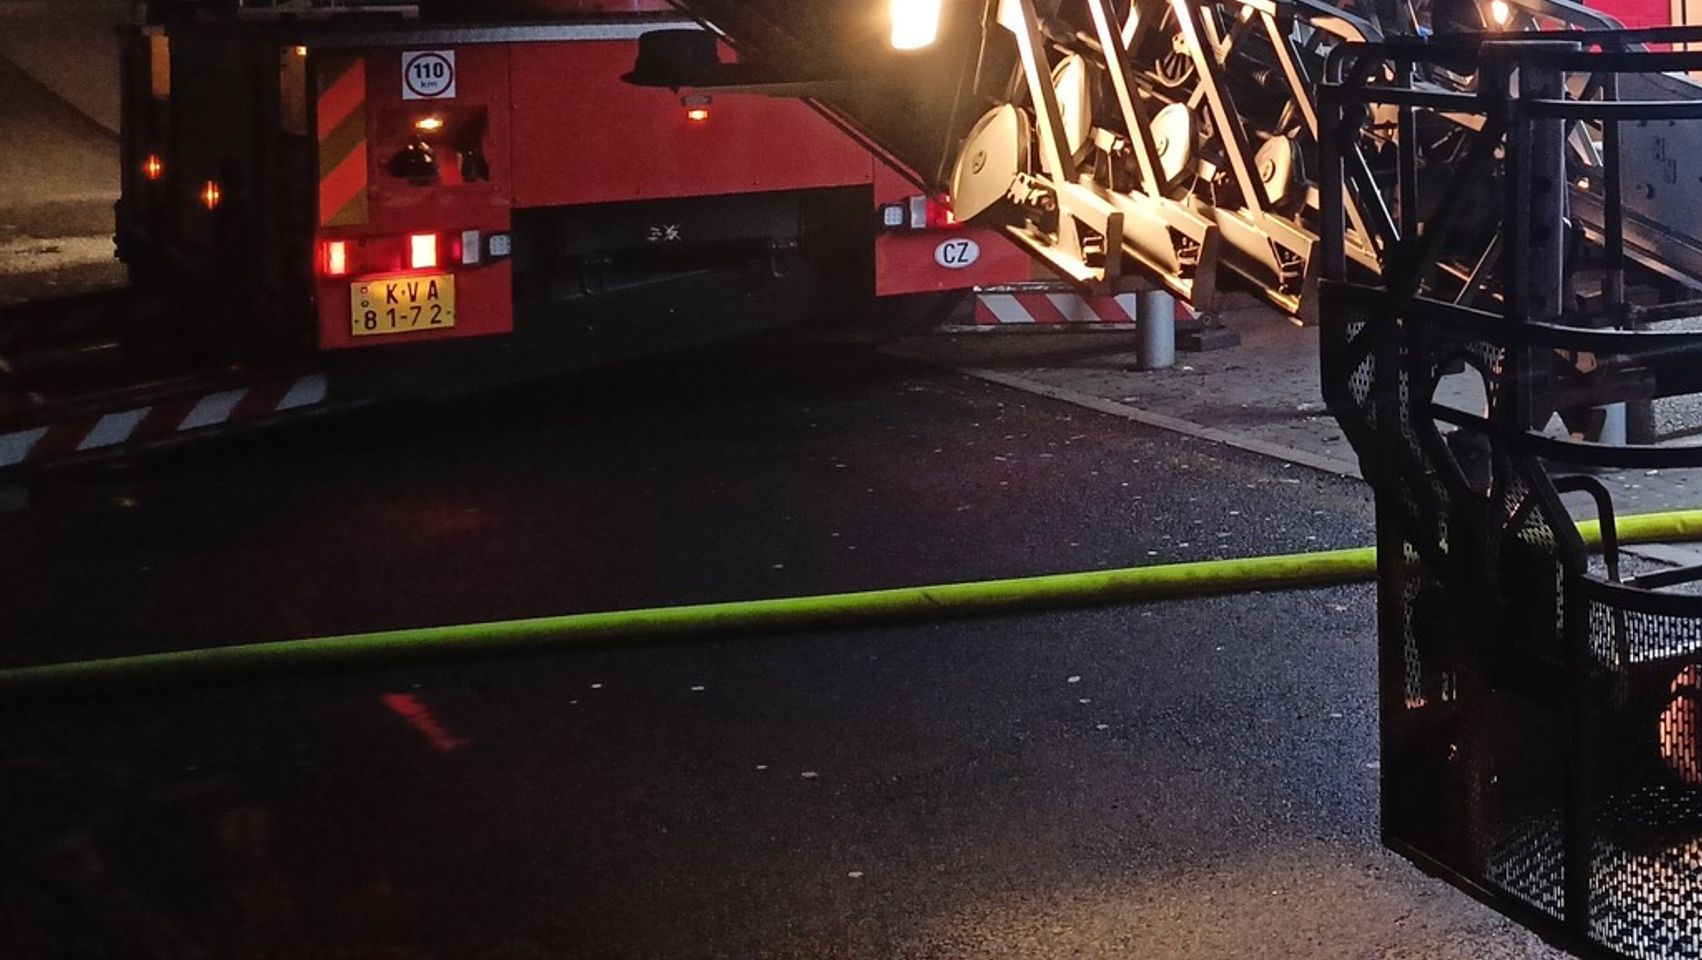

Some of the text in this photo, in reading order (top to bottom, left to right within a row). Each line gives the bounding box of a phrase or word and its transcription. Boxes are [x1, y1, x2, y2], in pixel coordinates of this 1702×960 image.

[413, 62, 444, 79] 110
[943, 241, 969, 264] CZ
[364, 303, 442, 330] 81-72
